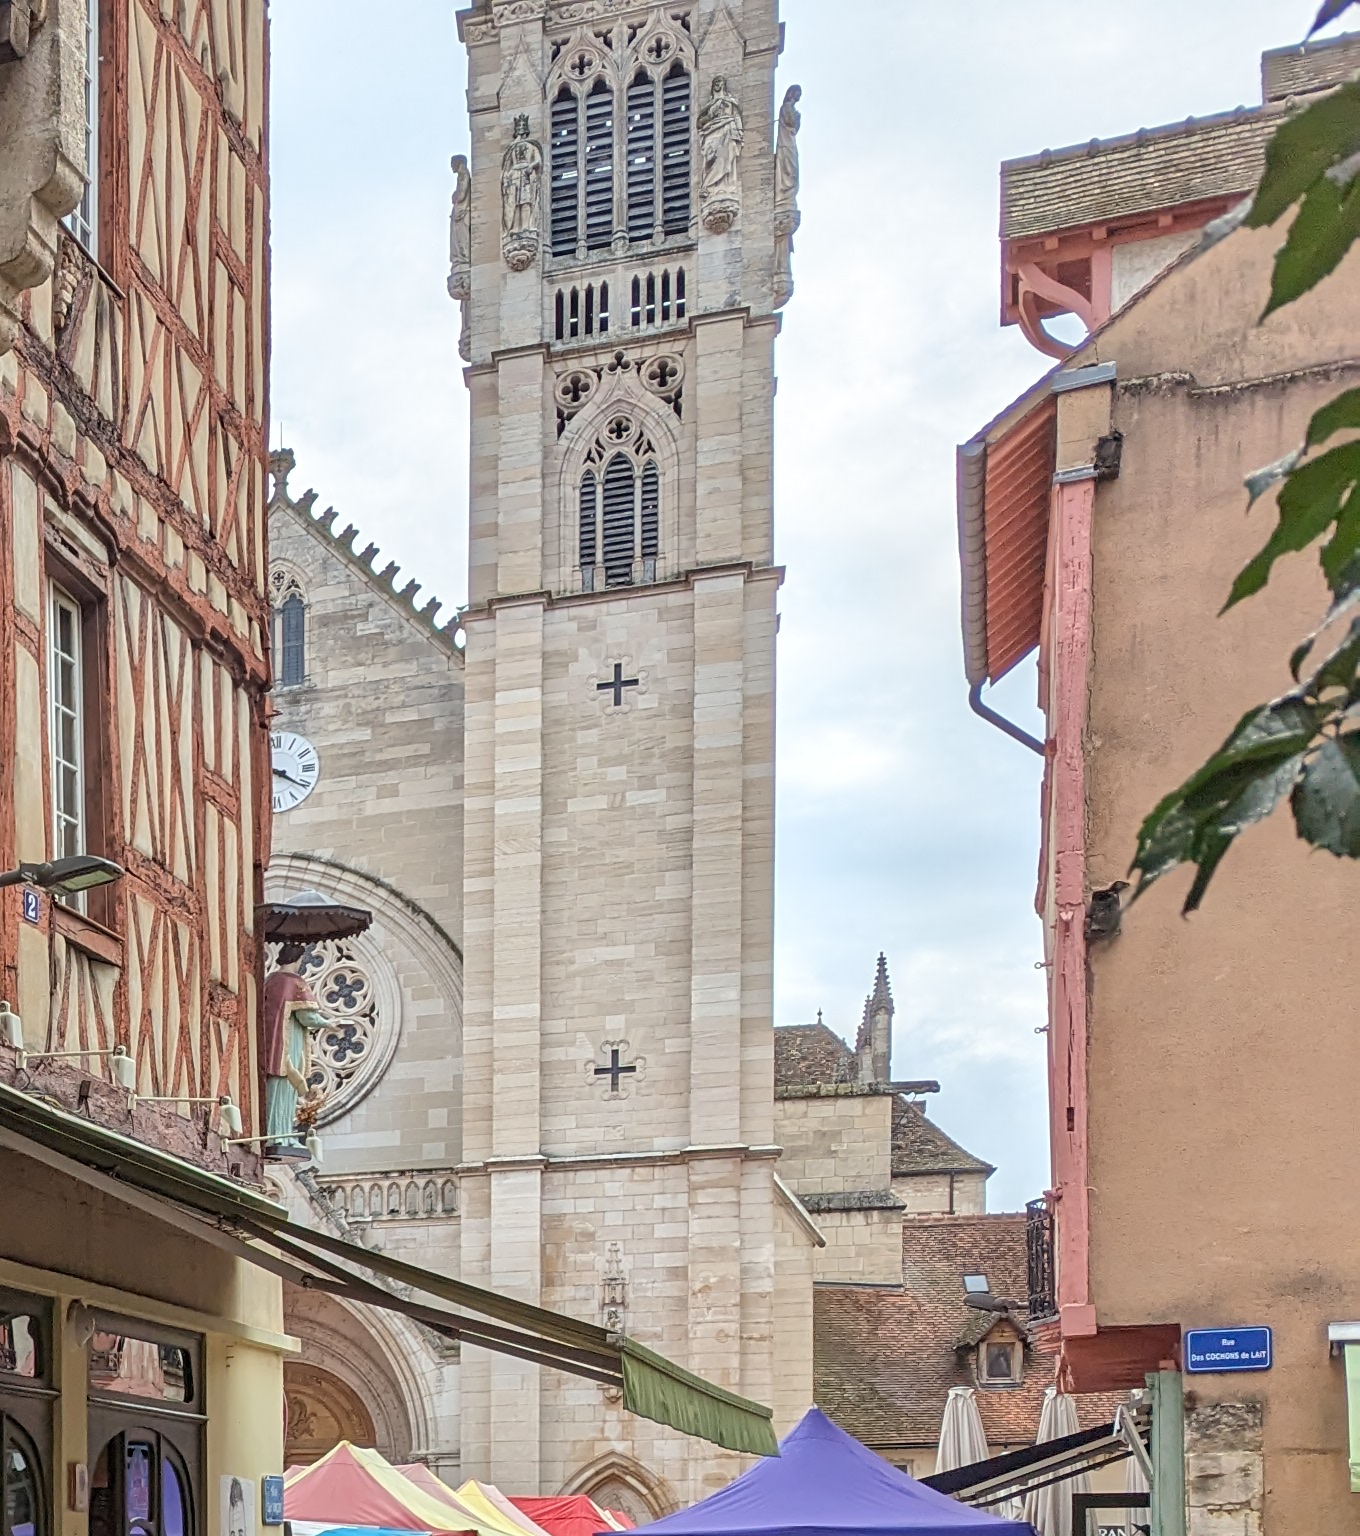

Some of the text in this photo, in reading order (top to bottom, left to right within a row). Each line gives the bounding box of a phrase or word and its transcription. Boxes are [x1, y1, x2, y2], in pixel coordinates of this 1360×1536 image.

[28, 895, 36, 917] 2
[1221, 1338, 1235, 1346] Rue
[1206, 1352, 1239, 1360] COCHONS
